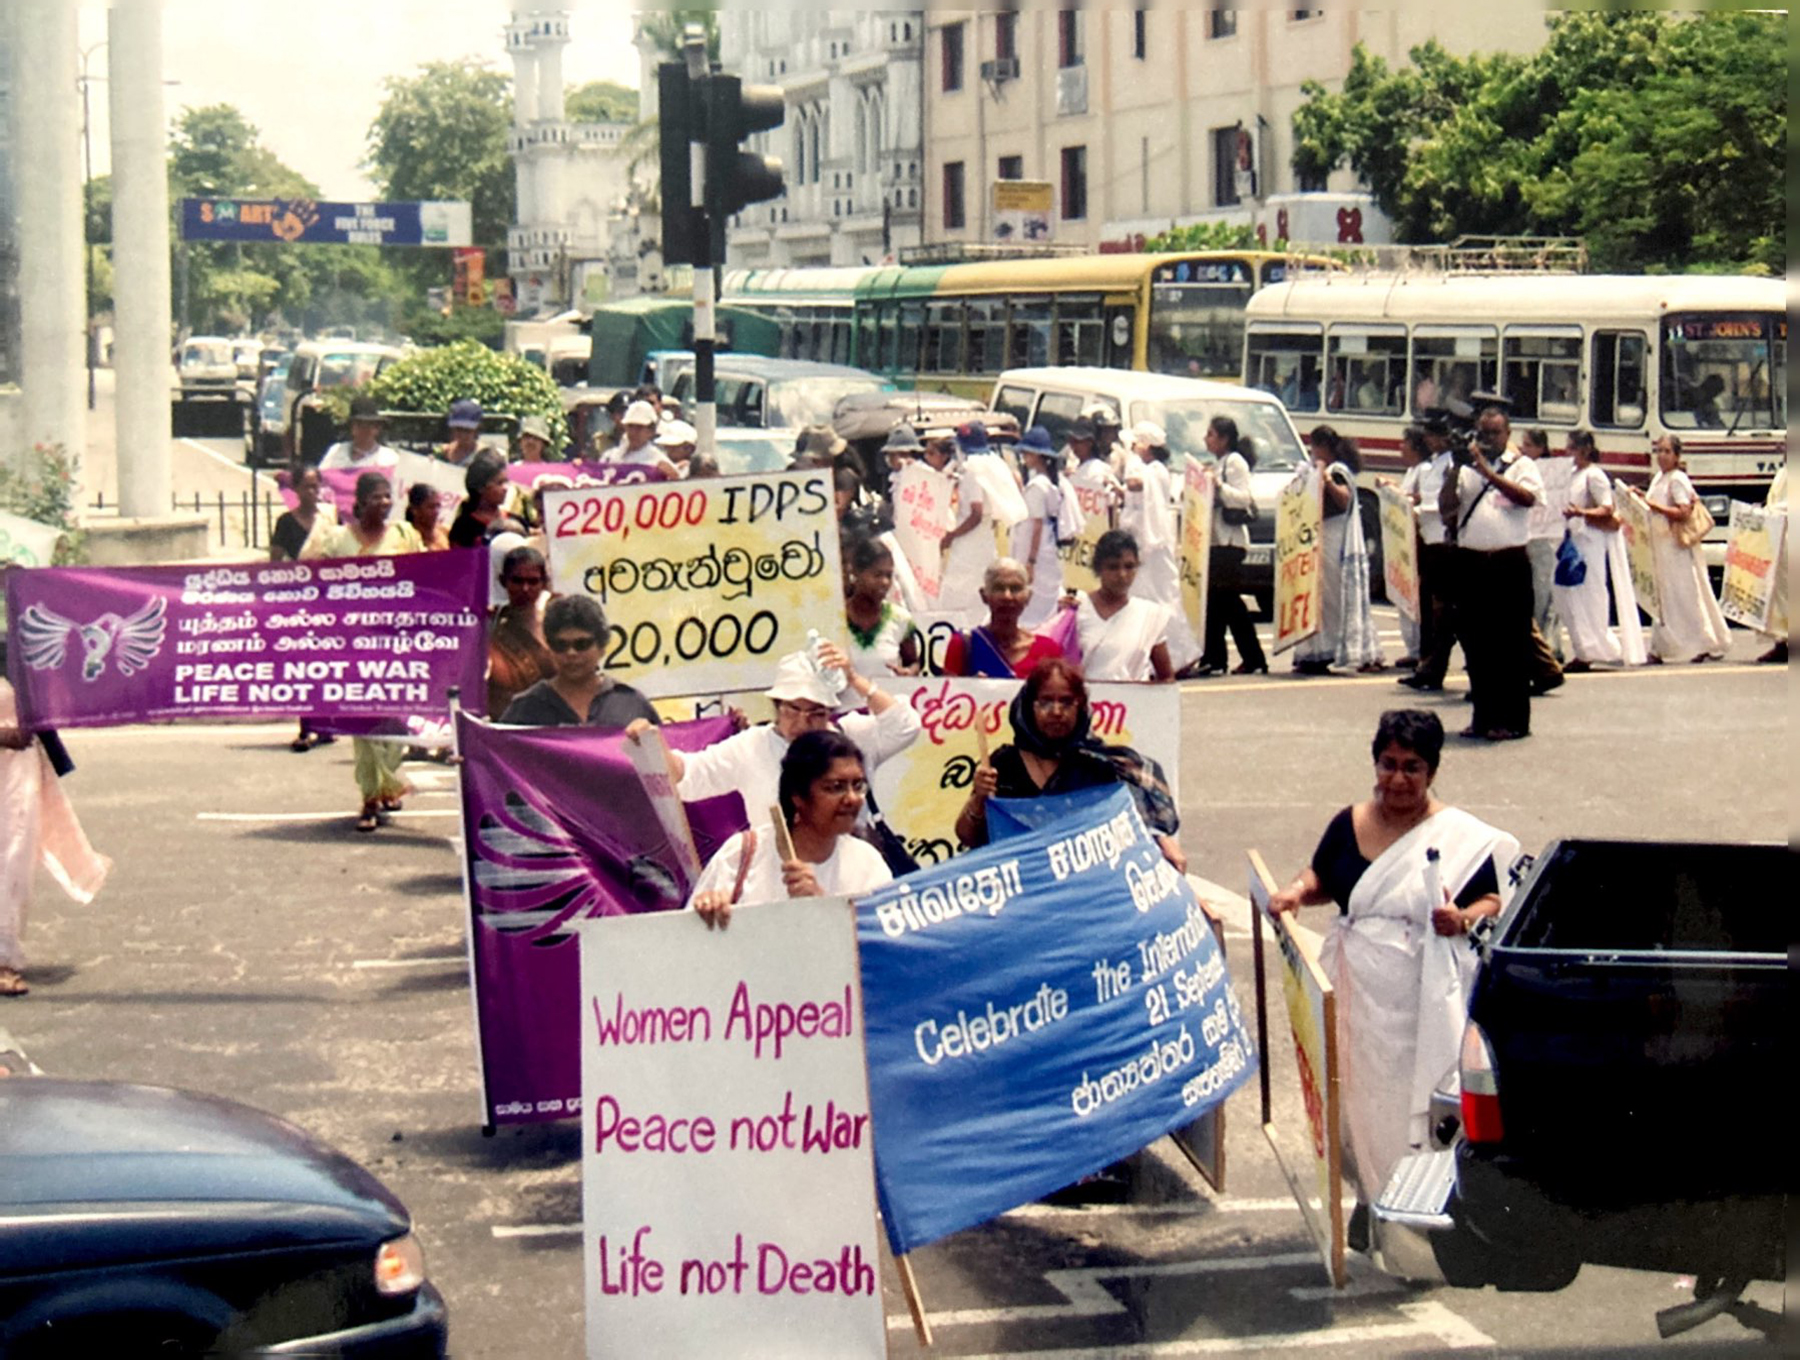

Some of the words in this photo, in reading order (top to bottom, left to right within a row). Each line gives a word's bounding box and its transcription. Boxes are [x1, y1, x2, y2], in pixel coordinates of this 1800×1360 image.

[556, 489, 707, 541] 220,000
[718, 479, 828, 525] IDPS
[175, 661, 275, 682] PEACE
[284, 661, 349, 680] NOT
[357, 660, 431, 680] WAR
[597, 610, 779, 671] 20,000
[174, 684, 240, 703] LIFE
[249, 684, 314, 702] NOT
[323, 682, 428, 701] DEATH
[593, 990, 711, 1046] Women
[724, 980, 853, 1060] Appeal
[914, 983, 1070, 1066] Celebrate
[1092, 957, 1132, 1004] the
[595, 1094, 717, 1155] Peace
[729, 1090, 798, 1153] not
[802, 1099, 869, 1154] War
[599, 1225, 665, 1297] Life
[680, 1233, 749, 1297] not
[757, 1242, 876, 1297] Death
